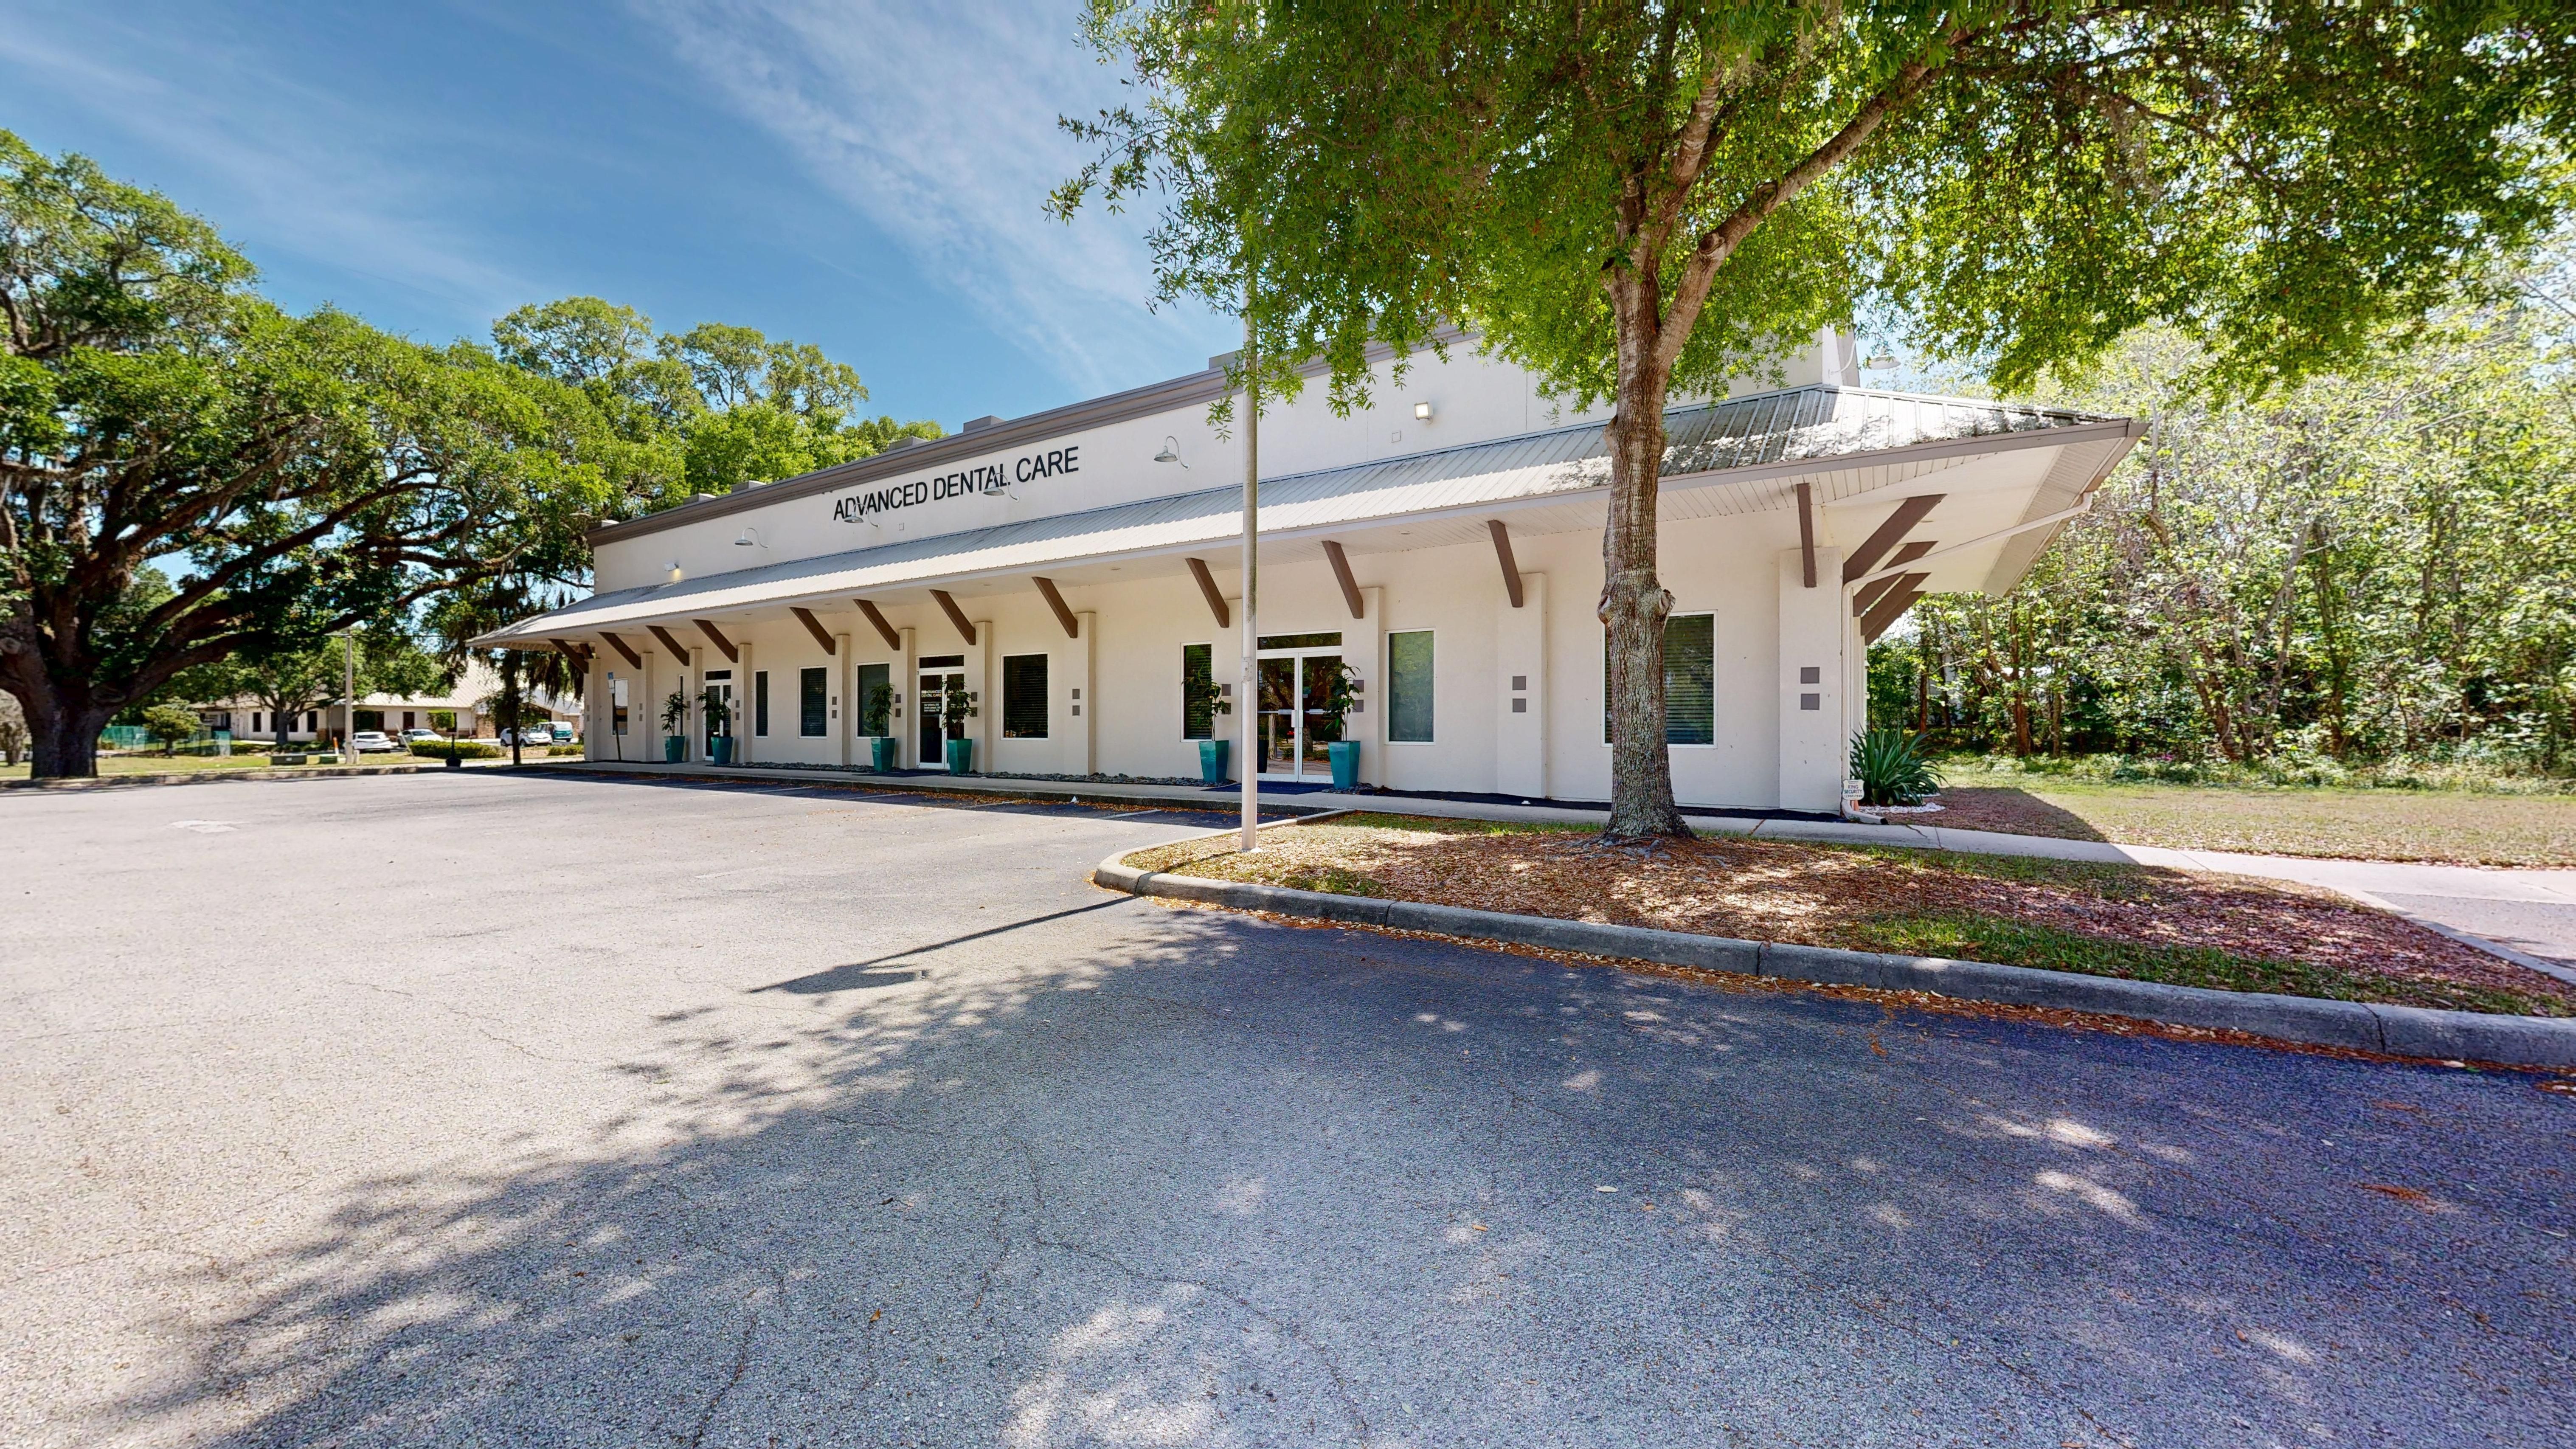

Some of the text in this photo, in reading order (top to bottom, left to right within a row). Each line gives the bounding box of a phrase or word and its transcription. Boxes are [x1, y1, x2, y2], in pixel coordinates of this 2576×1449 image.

[833, 446, 1079, 521] ADVANCED DENTAL CARE
